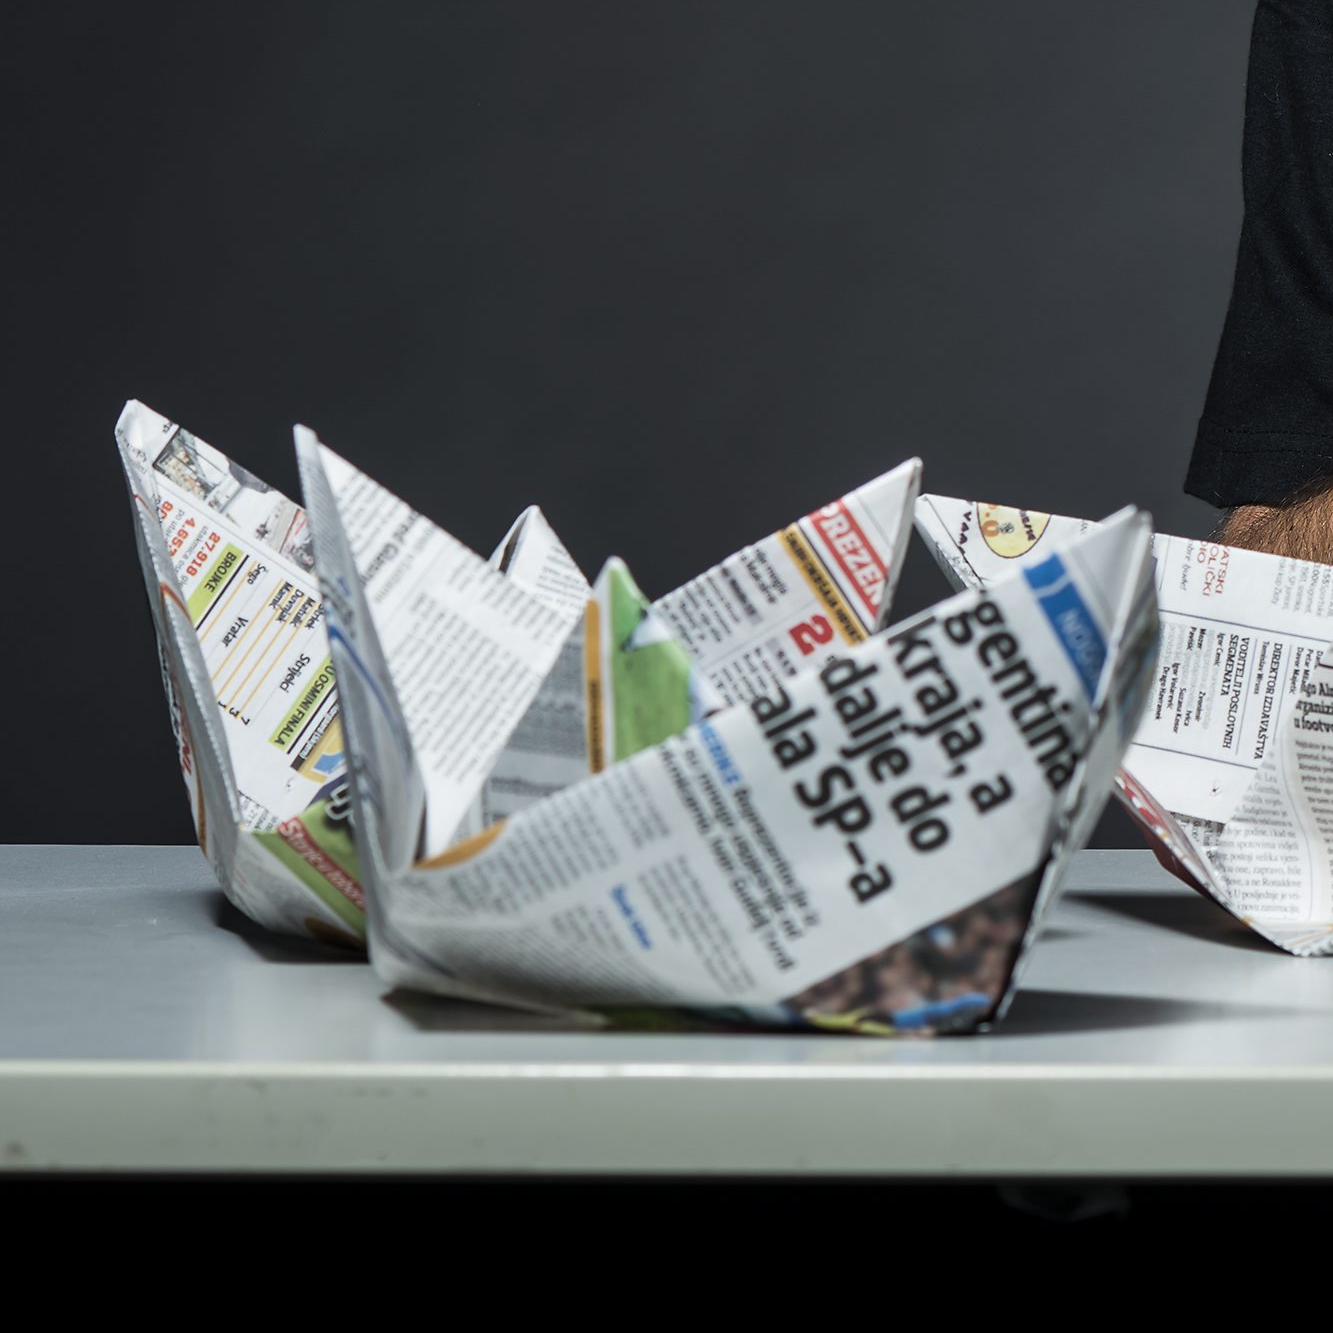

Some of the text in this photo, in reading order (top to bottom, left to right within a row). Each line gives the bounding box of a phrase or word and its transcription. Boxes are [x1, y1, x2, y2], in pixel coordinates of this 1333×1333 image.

[205, 552, 236, 590] BROJKE
[245, 563, 266, 585] Šego
[274, 588, 304, 621] Duvnjak
[222, 617, 248, 646] Vratar
[789, 614, 833, 654] 2
[279, 654, 310, 691] Strijelci
[1221, 634, 1238, 695] SEGMENATA
[300, 674, 328, 709] OSMINI
[1223, 637, 1249, 748] VODITELJI POSLOVNIH
[1254, 643, 1282, 758] DIREKTOR IZDAVAŠTVA
[228, 707, 239, 717] 3
[238, 714, 250, 725] 7
[275, 709, 304, 744] FINALA
[883, 619, 1015, 812] kraja, a
[813, 659, 960, 851] dalje do
[796, 766, 896, 900] SP-a
